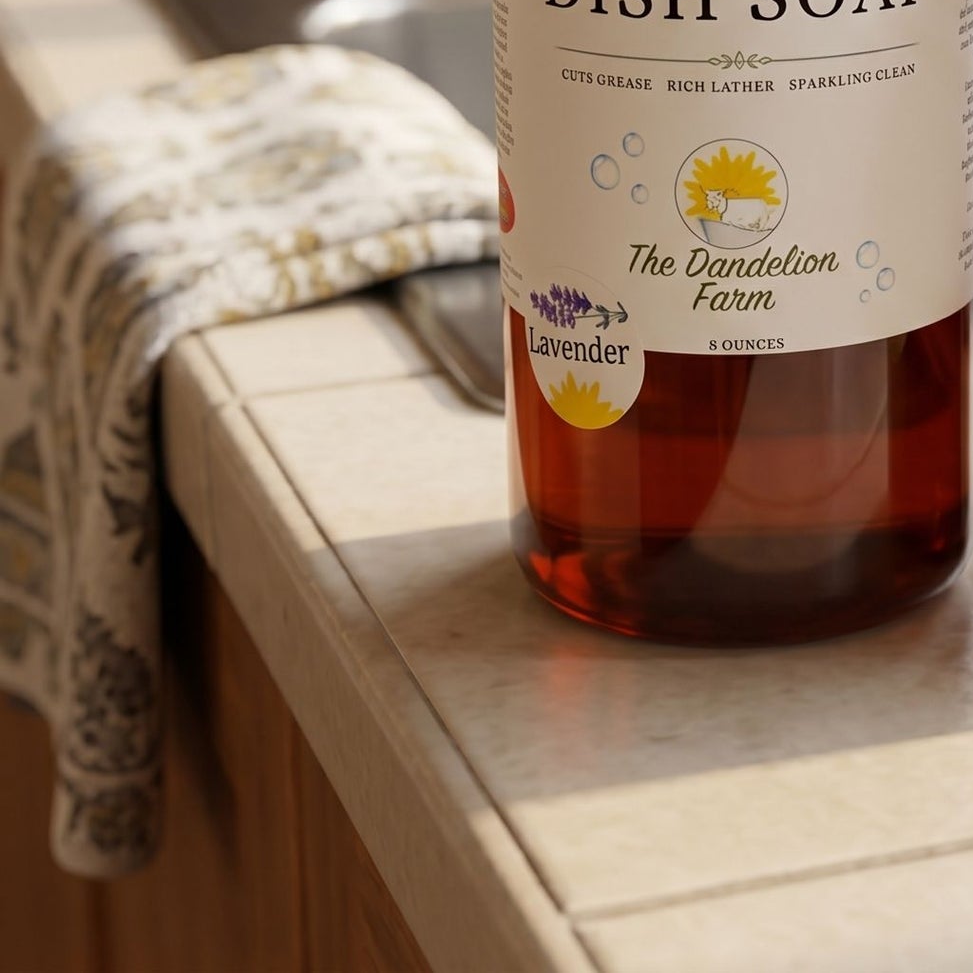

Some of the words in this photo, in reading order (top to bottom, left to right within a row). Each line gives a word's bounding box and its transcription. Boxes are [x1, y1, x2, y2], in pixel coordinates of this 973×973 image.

[561, 68, 594, 85] CUTS
[596, 73, 653, 91] GREASE
[667, 79, 705, 93] RICH
[711, 80, 775, 93] LATHER
[788, 71, 872, 91] SPARKLING
[875, 62, 915, 81] CLEAN
[628, 243, 677, 277] The
[684, 243, 840, 279] Dandelion
[692, 282, 776, 312] Farm
[528, 326, 630, 365] Lavender
[708, 339, 718, 351] 8
[721, 337, 785, 351] OUNCES
